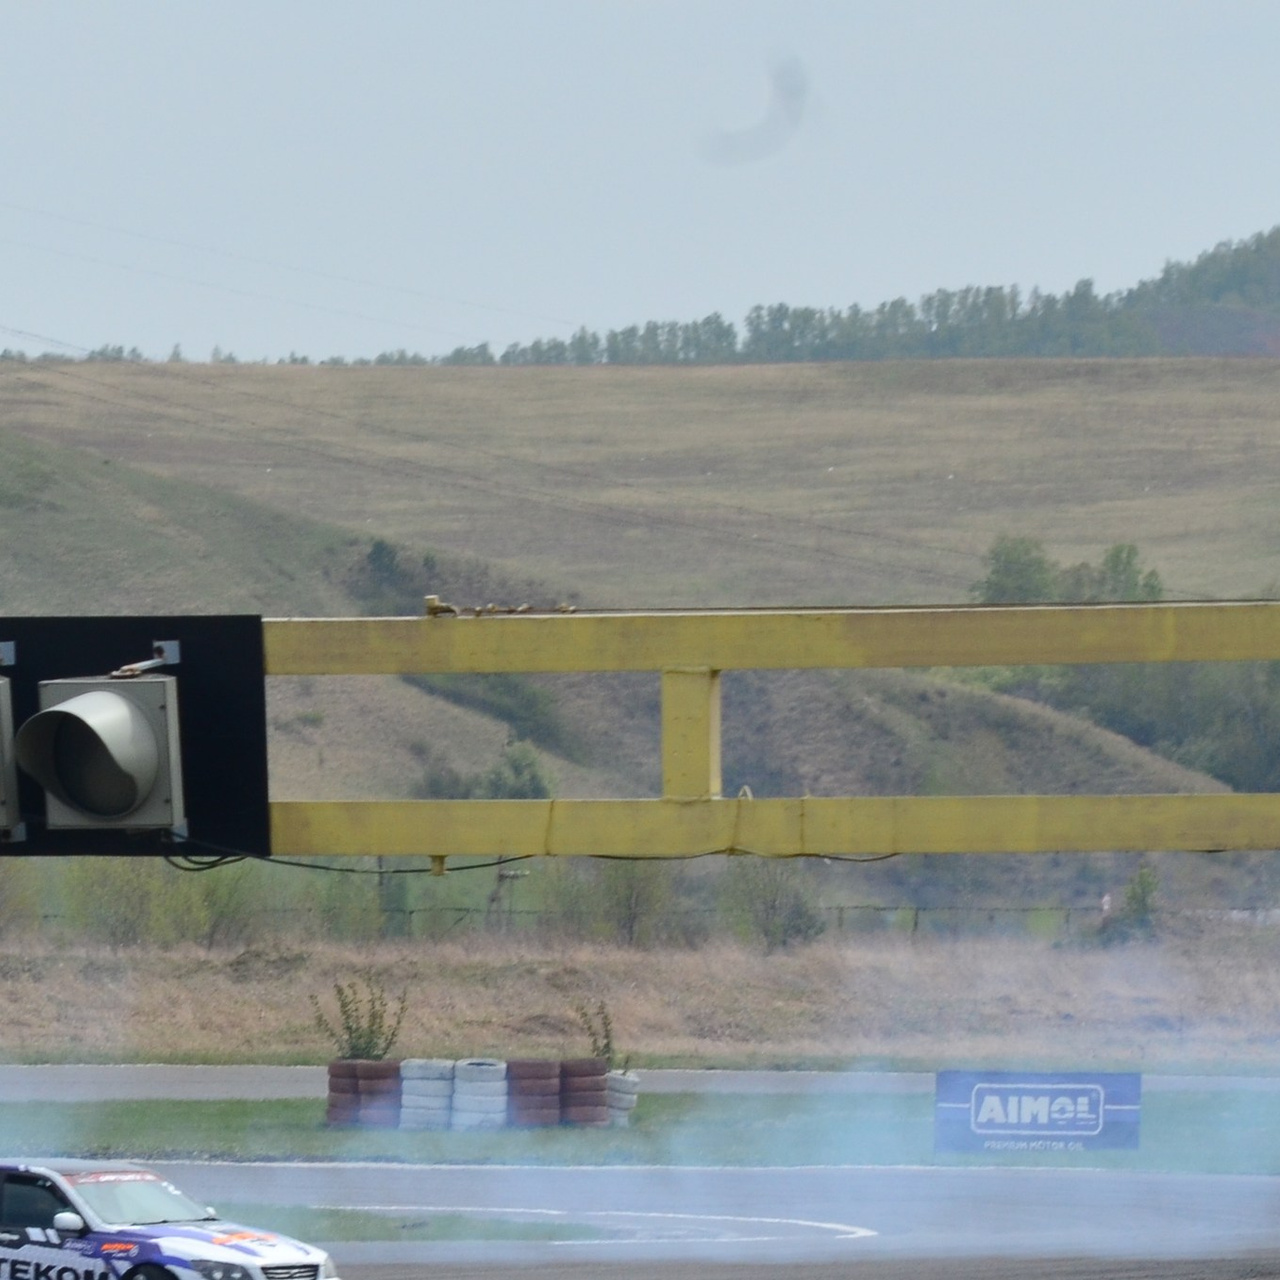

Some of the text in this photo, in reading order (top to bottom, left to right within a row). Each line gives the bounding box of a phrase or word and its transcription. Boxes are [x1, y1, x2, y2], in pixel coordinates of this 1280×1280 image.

[976, 1094, 1097, 1125] AIMOL
[1029, 1139, 1066, 1150] MOTOR
[1067, 1140, 1085, 1150] OIL
